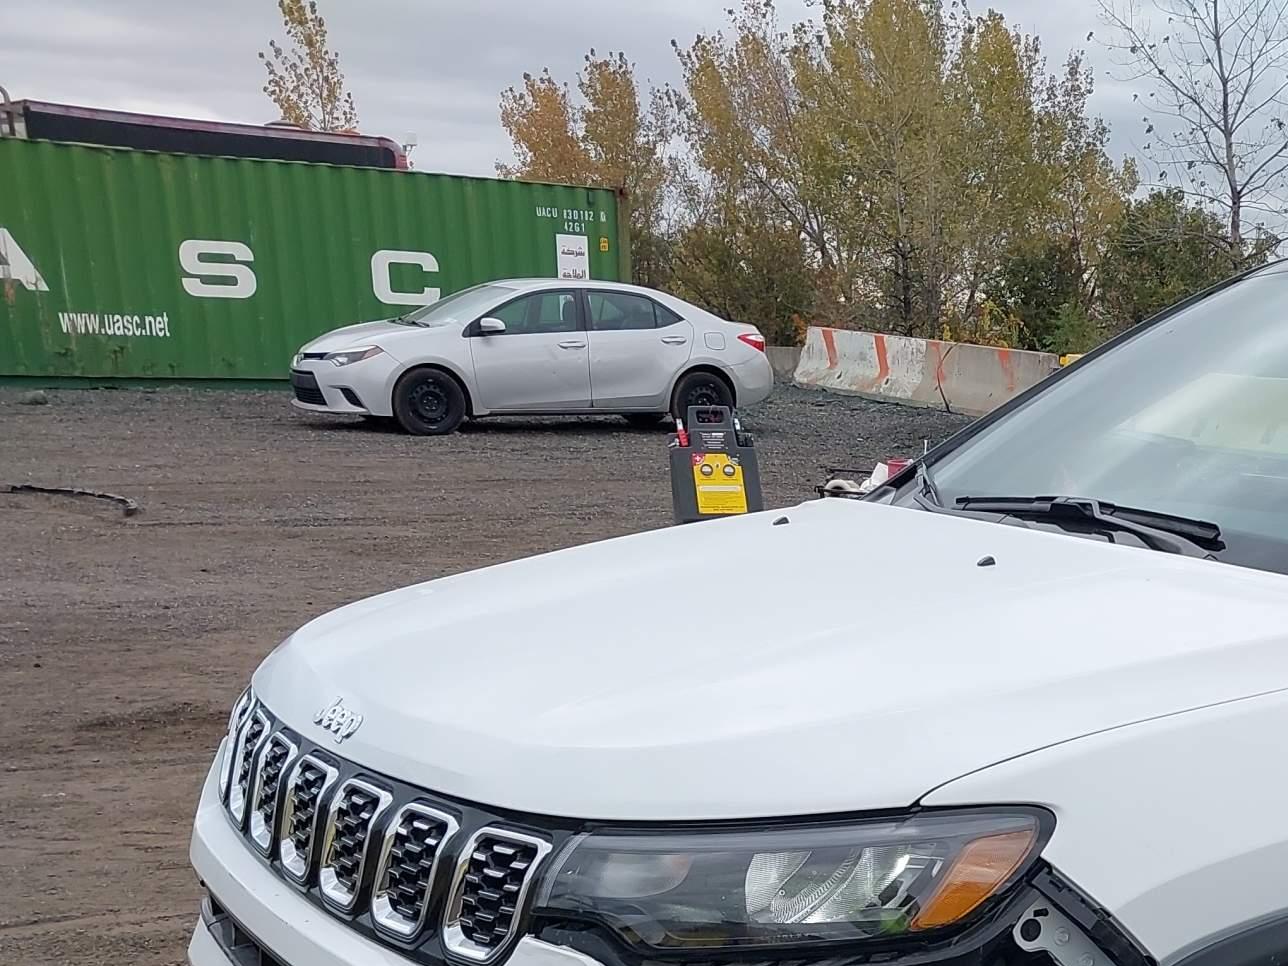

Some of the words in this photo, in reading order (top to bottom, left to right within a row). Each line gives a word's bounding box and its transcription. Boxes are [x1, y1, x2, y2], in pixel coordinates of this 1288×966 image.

[536, 206, 558, 218] UACU
[58, 311, 170, 337] www.uasc.net
[313, 696, 364, 744] Jeep
